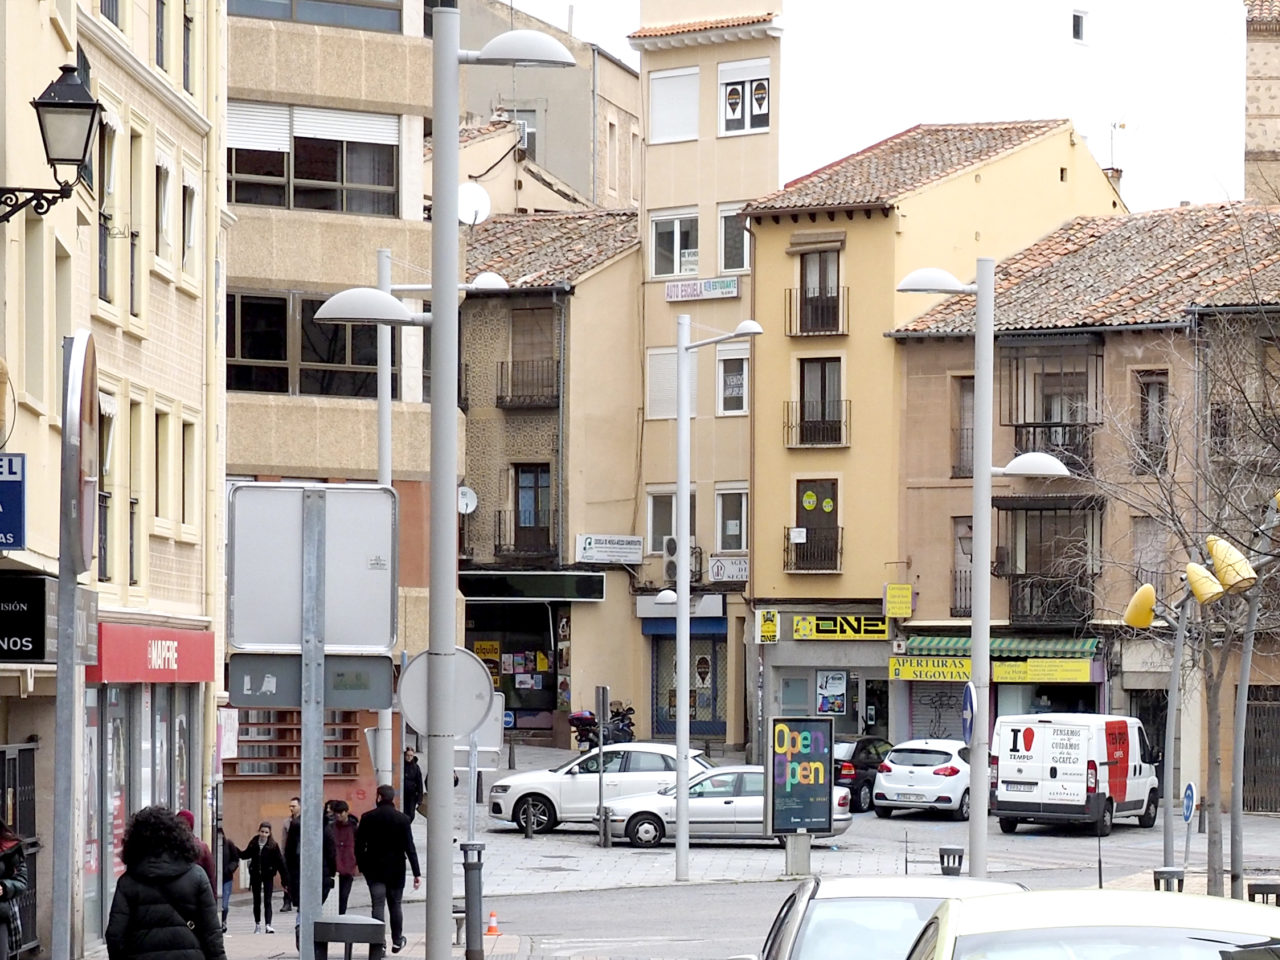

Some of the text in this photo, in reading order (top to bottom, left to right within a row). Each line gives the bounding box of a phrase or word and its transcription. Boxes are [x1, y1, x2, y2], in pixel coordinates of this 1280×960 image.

[667, 283, 679, 299] AUTO
[681, 281, 703, 298] ESCUELA
[151, 640, 178, 670] MAPFRE
[893, 658, 964, 668] APERTURAS
[1052, 728, 1081, 737] PENSAMOS
[1051, 742, 1080, 750] CUIDAMOS
